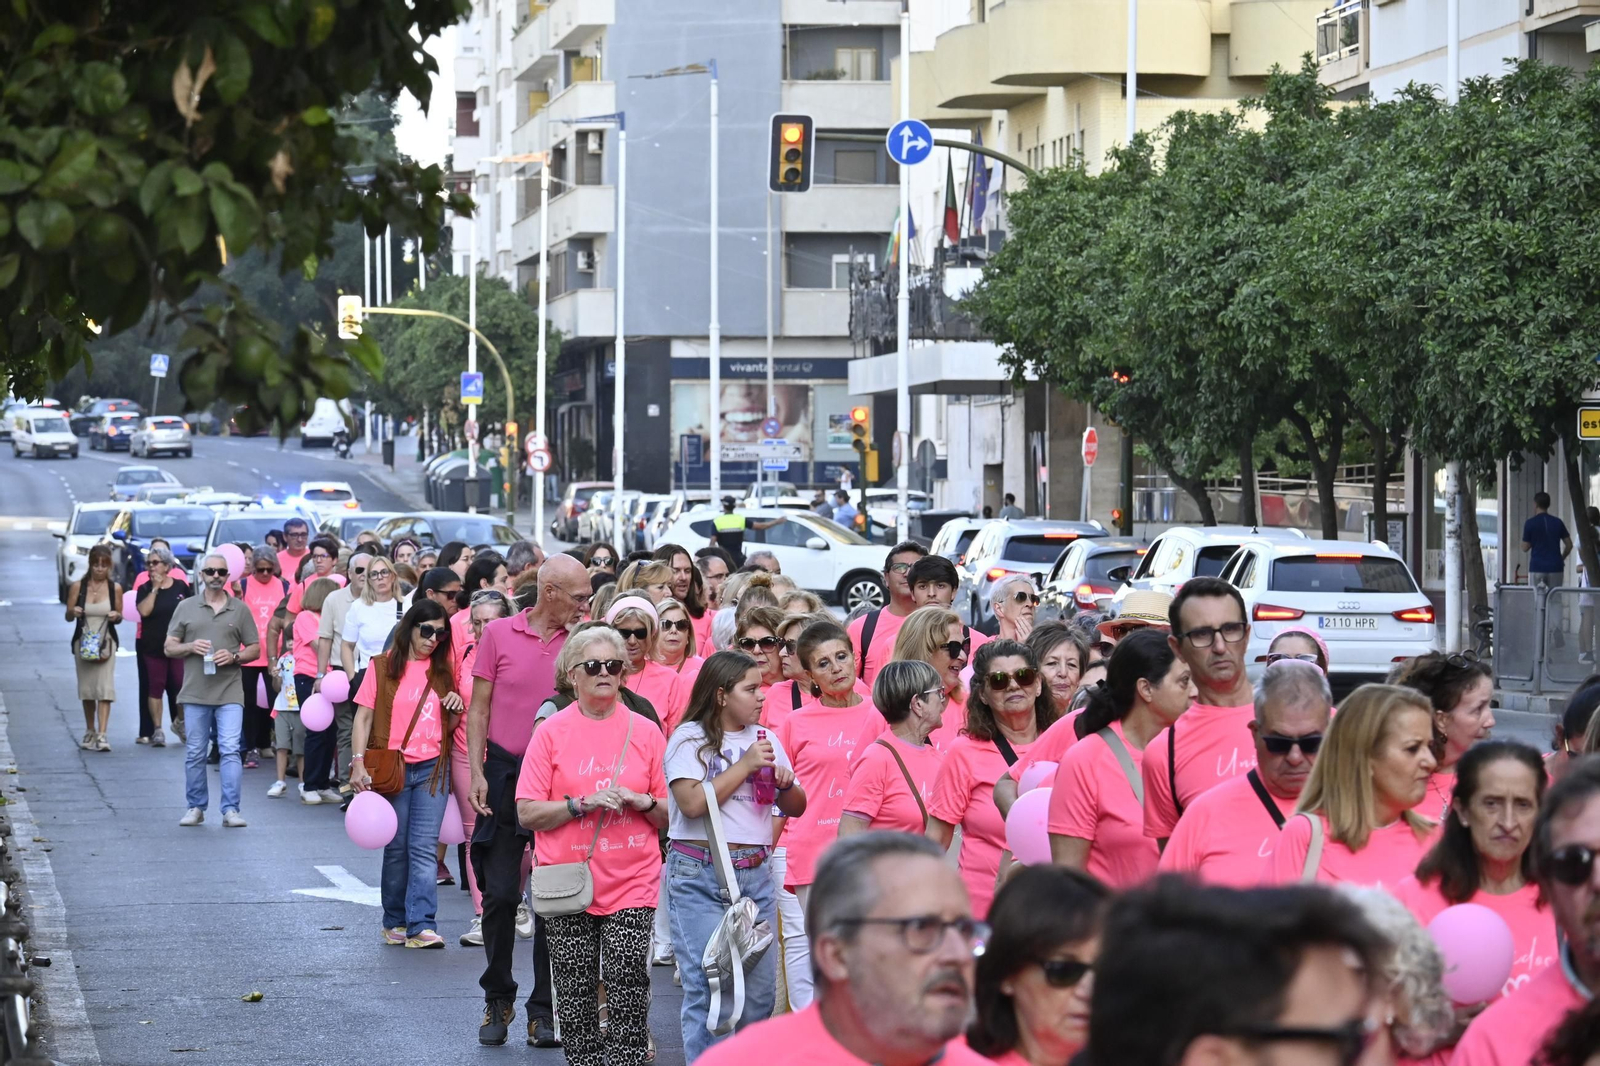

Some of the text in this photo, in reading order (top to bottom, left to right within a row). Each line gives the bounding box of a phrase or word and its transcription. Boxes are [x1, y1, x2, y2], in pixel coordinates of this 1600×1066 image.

[1582, 419, 1600, 429] es
[1325, 617, 1375, 628] 2110 HPR
[817, 817, 841, 826] Huelva
